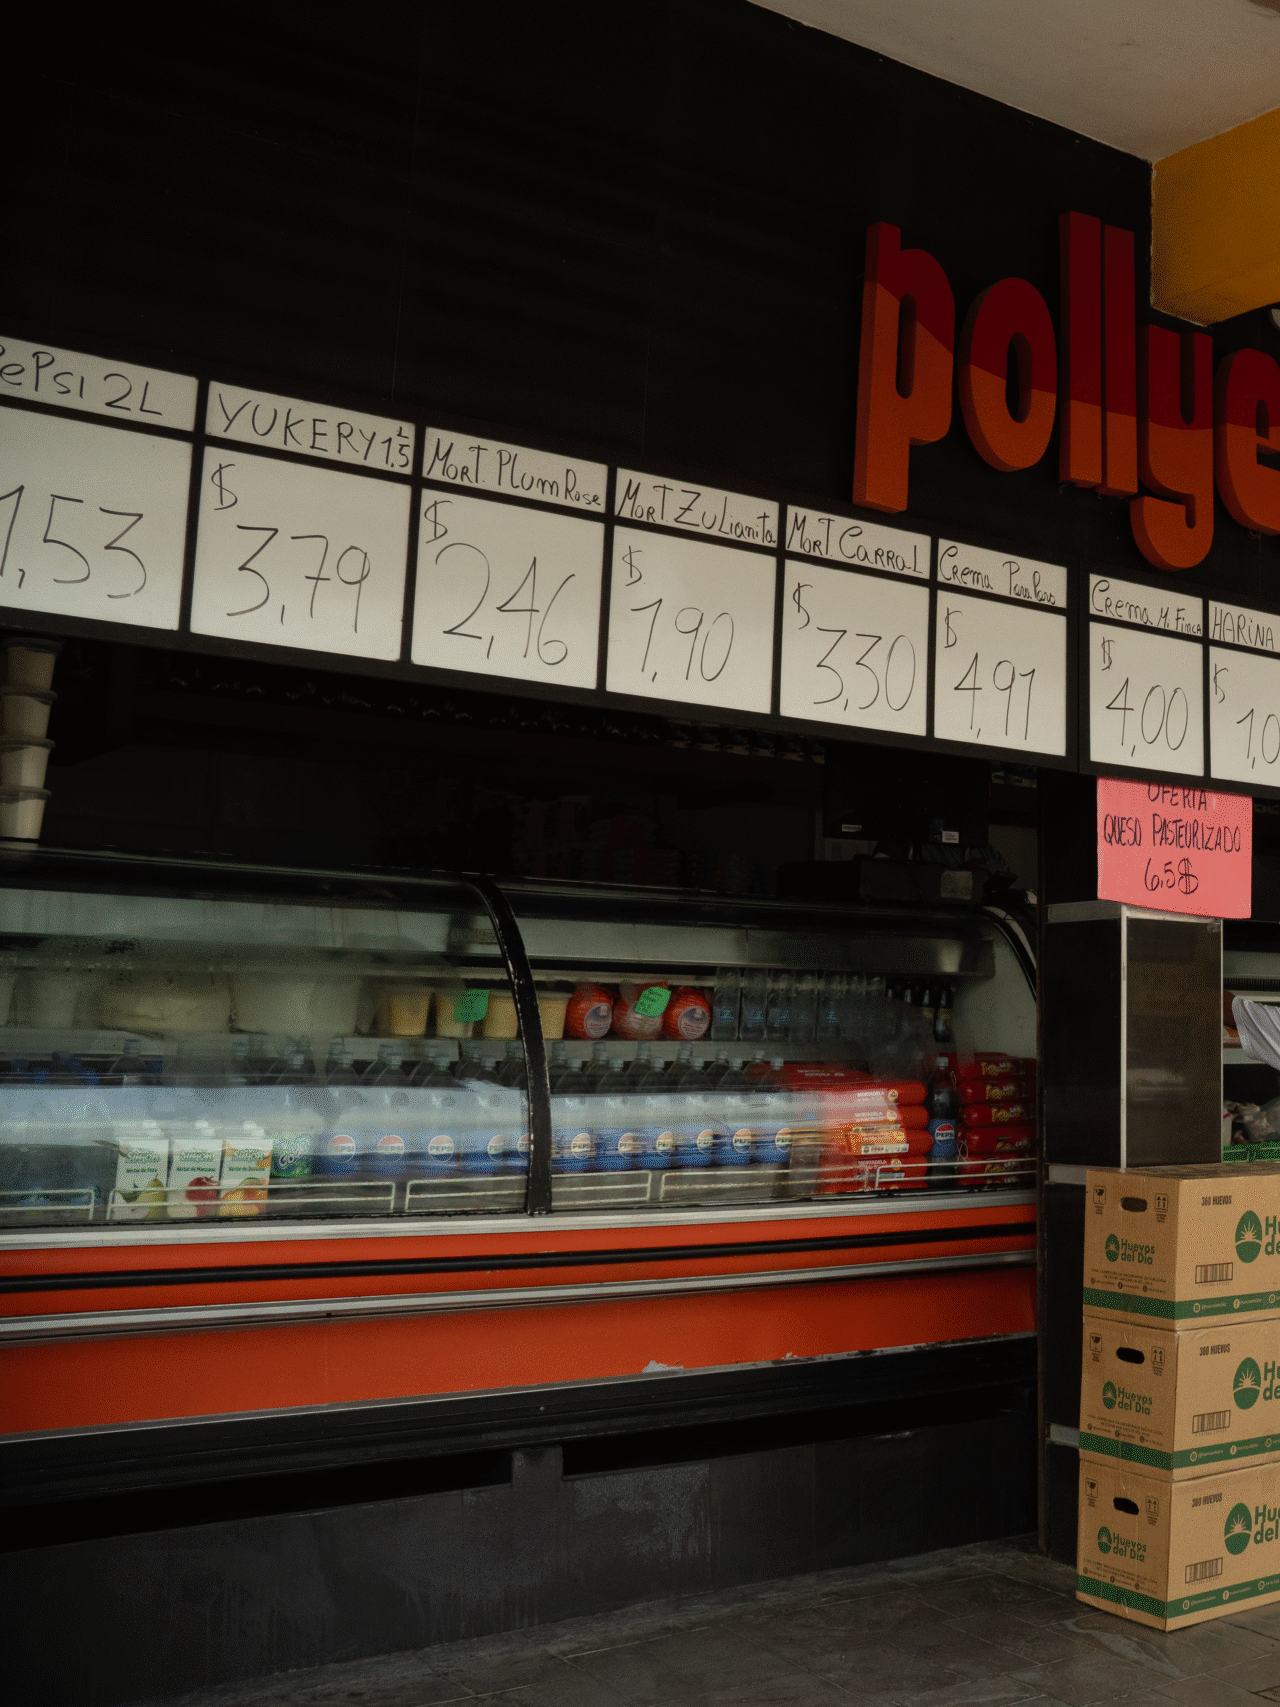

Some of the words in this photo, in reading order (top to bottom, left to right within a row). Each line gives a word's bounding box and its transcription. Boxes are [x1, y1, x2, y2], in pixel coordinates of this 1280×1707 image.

[424, 501, 454, 543] $
[211, 463, 238, 510] $
[226, 525, 371, 633] 3,79
[621, 545, 643, 586] $
[435, 543, 575, 665] 2,46
[631, 598, 735, 682] 1,90
[792, 582, 814, 630] $
[813, 626, 916, 711] 3,30
[1101, 637, 1115, 671] $
[944, 607, 963, 648] $
[954, 652, 1036, 740] 4,91
[1213, 663, 1228, 703] $
[1105, 677, 1188, 757] 4,00
[1103, 813, 1142, 847] QUESO
[1152, 812, 1241, 853] PASTEURIZADO
[1212, 1195, 1232, 1206] HUEVOS
[1120, 1252, 1135, 1262] del
[1121, 1239, 1155, 1255] Huevos
[1210, 1343, 1231, 1356] HUEVOS
[1117, 1400, 1133, 1411] del
[1118, 1387, 1153, 1405] Huevos
[1112, 1532, 1147, 1552] Huevos
[1112, 1545, 1128, 1557] del
[1254, 1520, 1279, 1545] del
